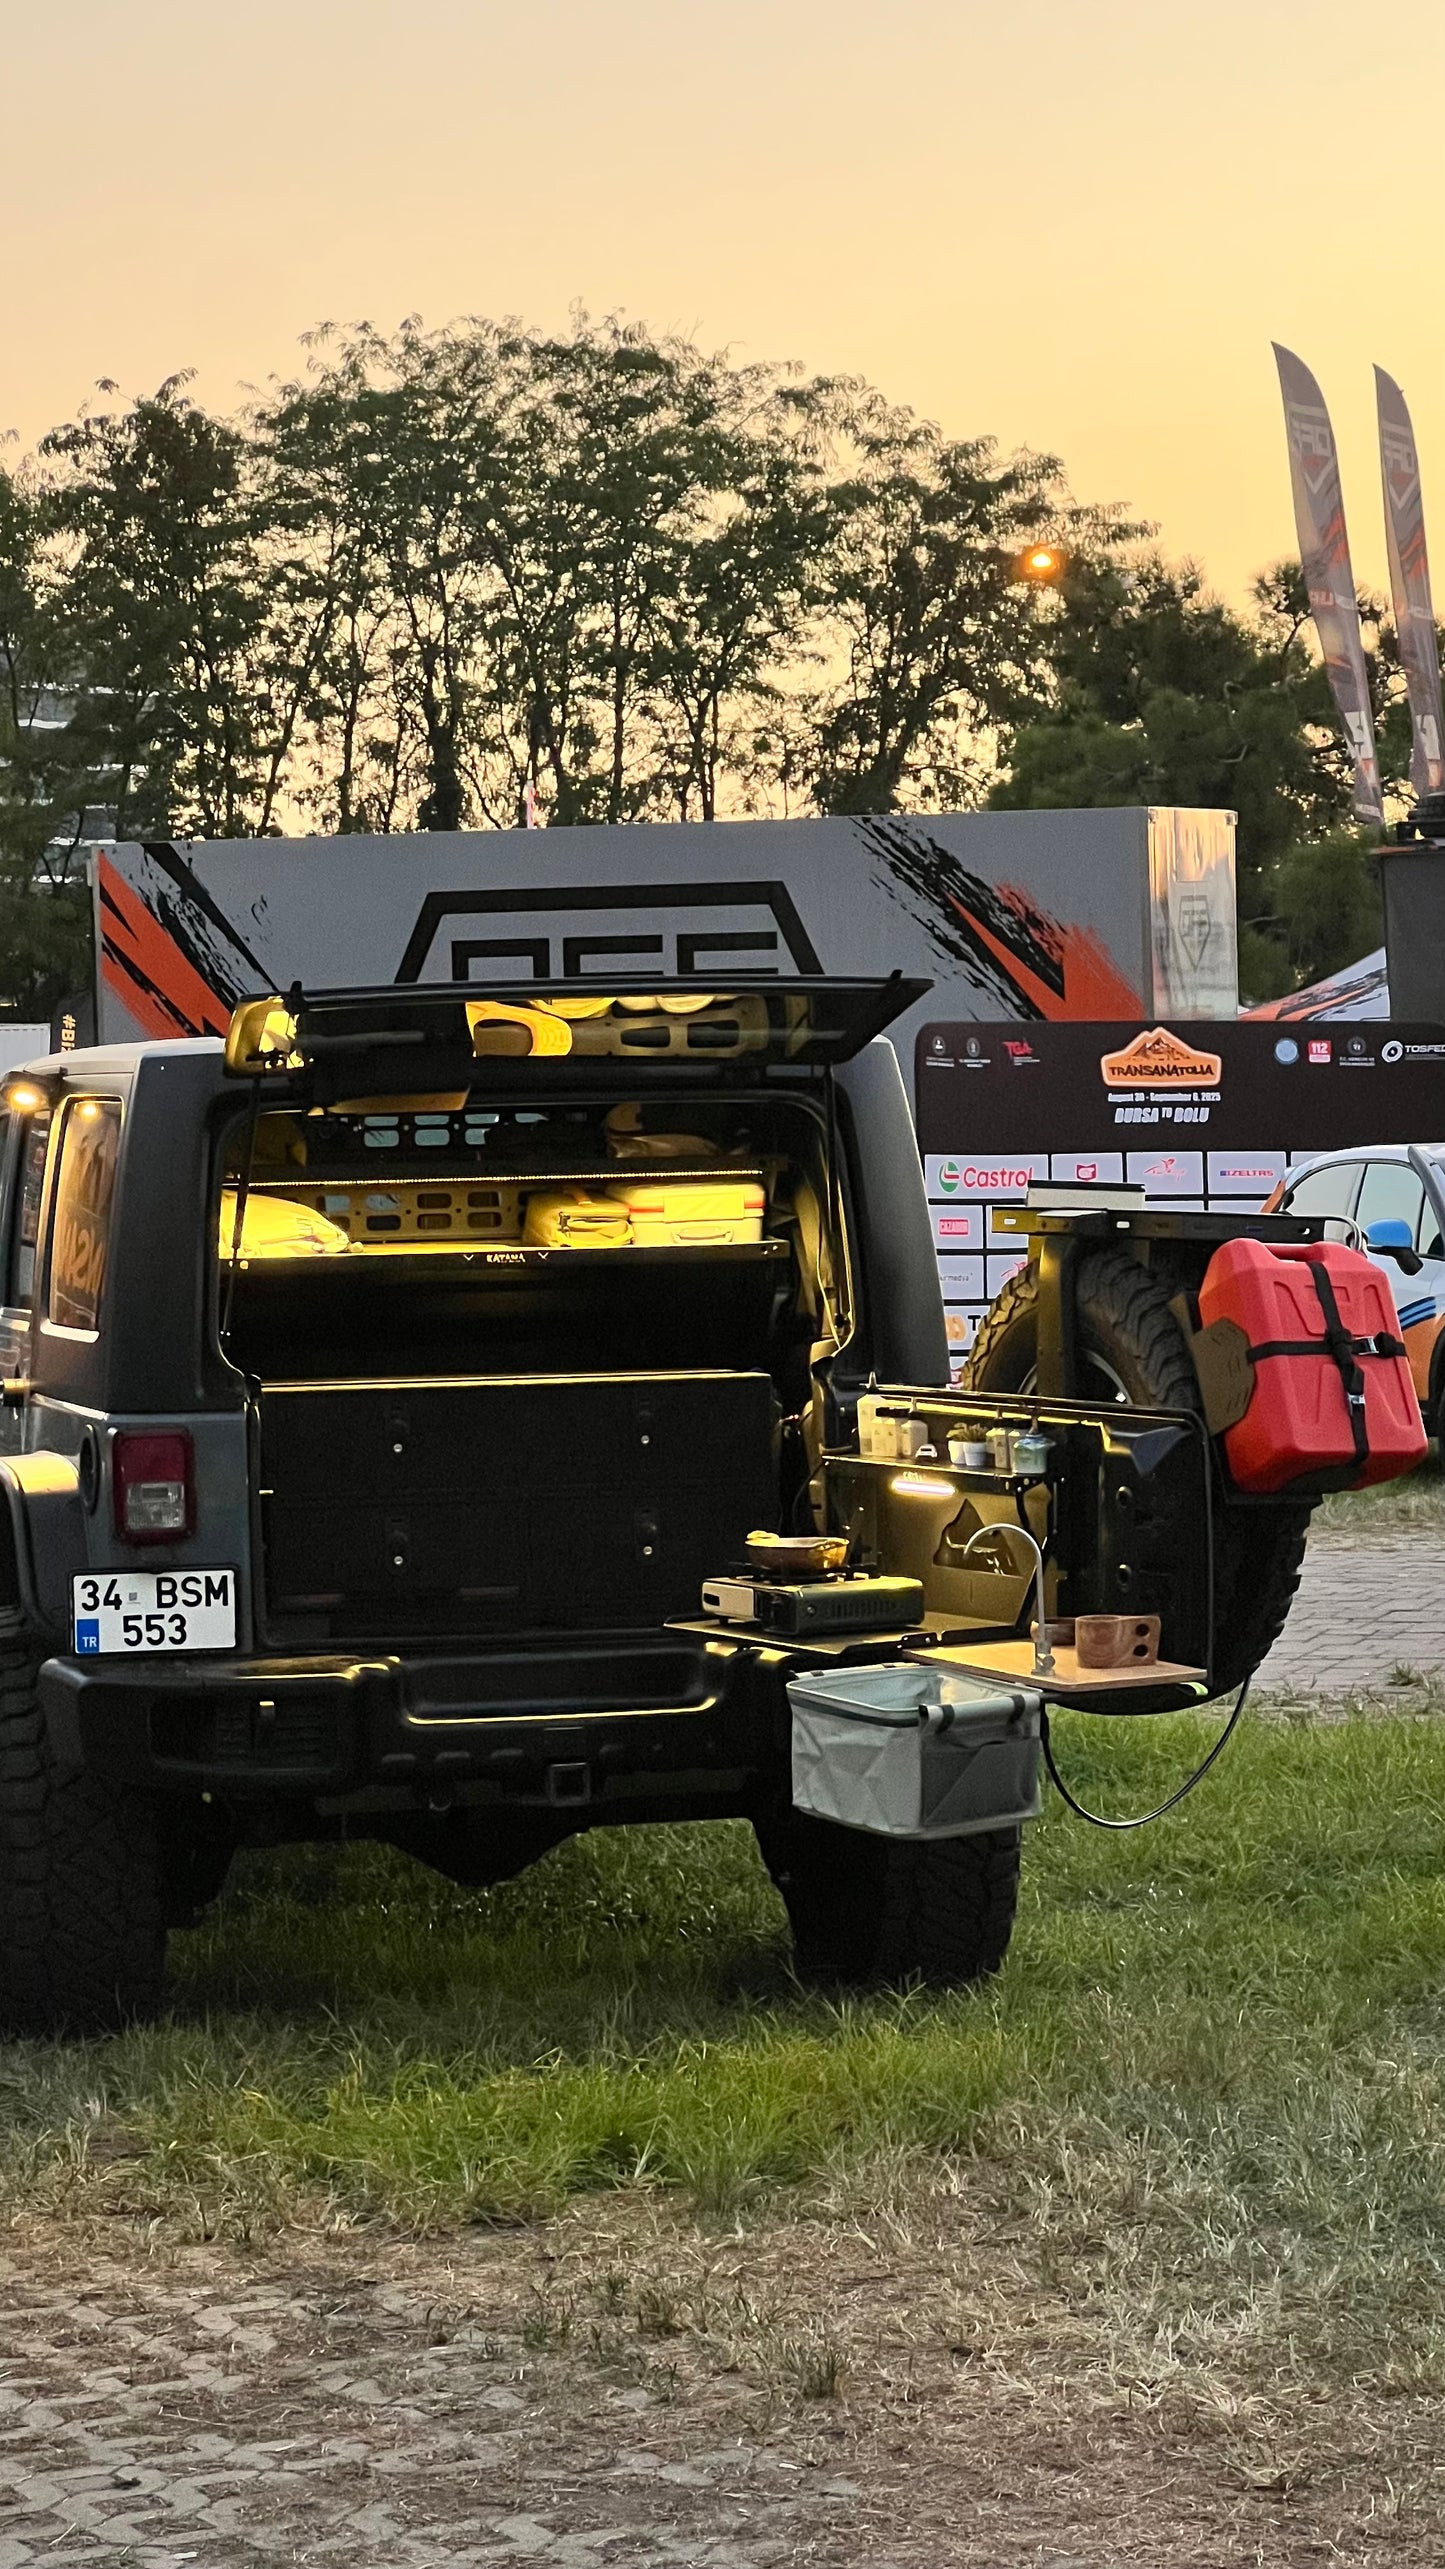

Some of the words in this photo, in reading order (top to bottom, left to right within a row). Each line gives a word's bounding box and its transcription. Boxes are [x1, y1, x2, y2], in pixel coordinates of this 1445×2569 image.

[1311, 1042, 1328, 1054] 112
[1109, 1064, 1214, 1077] TRANSANATOLIA
[1114, 1107, 1159, 1123] BURSA
[1173, 1107, 1210, 1122] BOLU
[963, 1166, 1033, 1188] Castrol
[81, 1579, 122, 1611] 34
[156, 1575, 228, 1609] BSM
[123, 1613, 187, 1647] 553
[82, 1636, 97, 1648] TR
